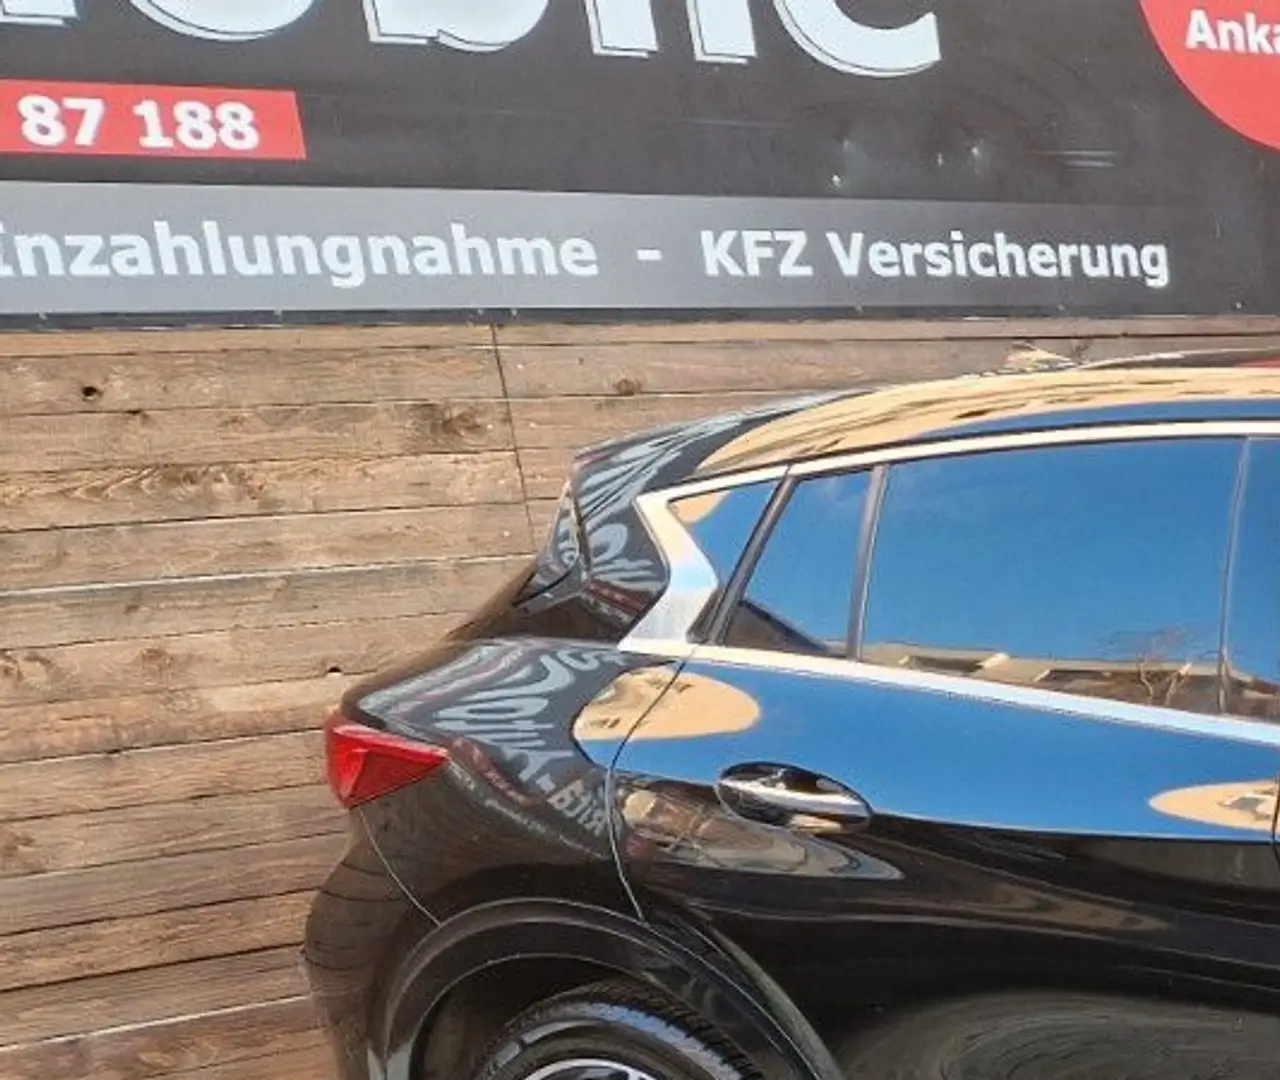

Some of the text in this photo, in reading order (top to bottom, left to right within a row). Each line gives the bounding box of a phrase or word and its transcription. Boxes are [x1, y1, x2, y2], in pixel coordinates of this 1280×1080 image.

[17, 95, 261, 150] 87 188
[636, 248, 662, 262] -
[700, 229, 814, 278] KFZ
[826, 230, 1169, 288] Versicherung
